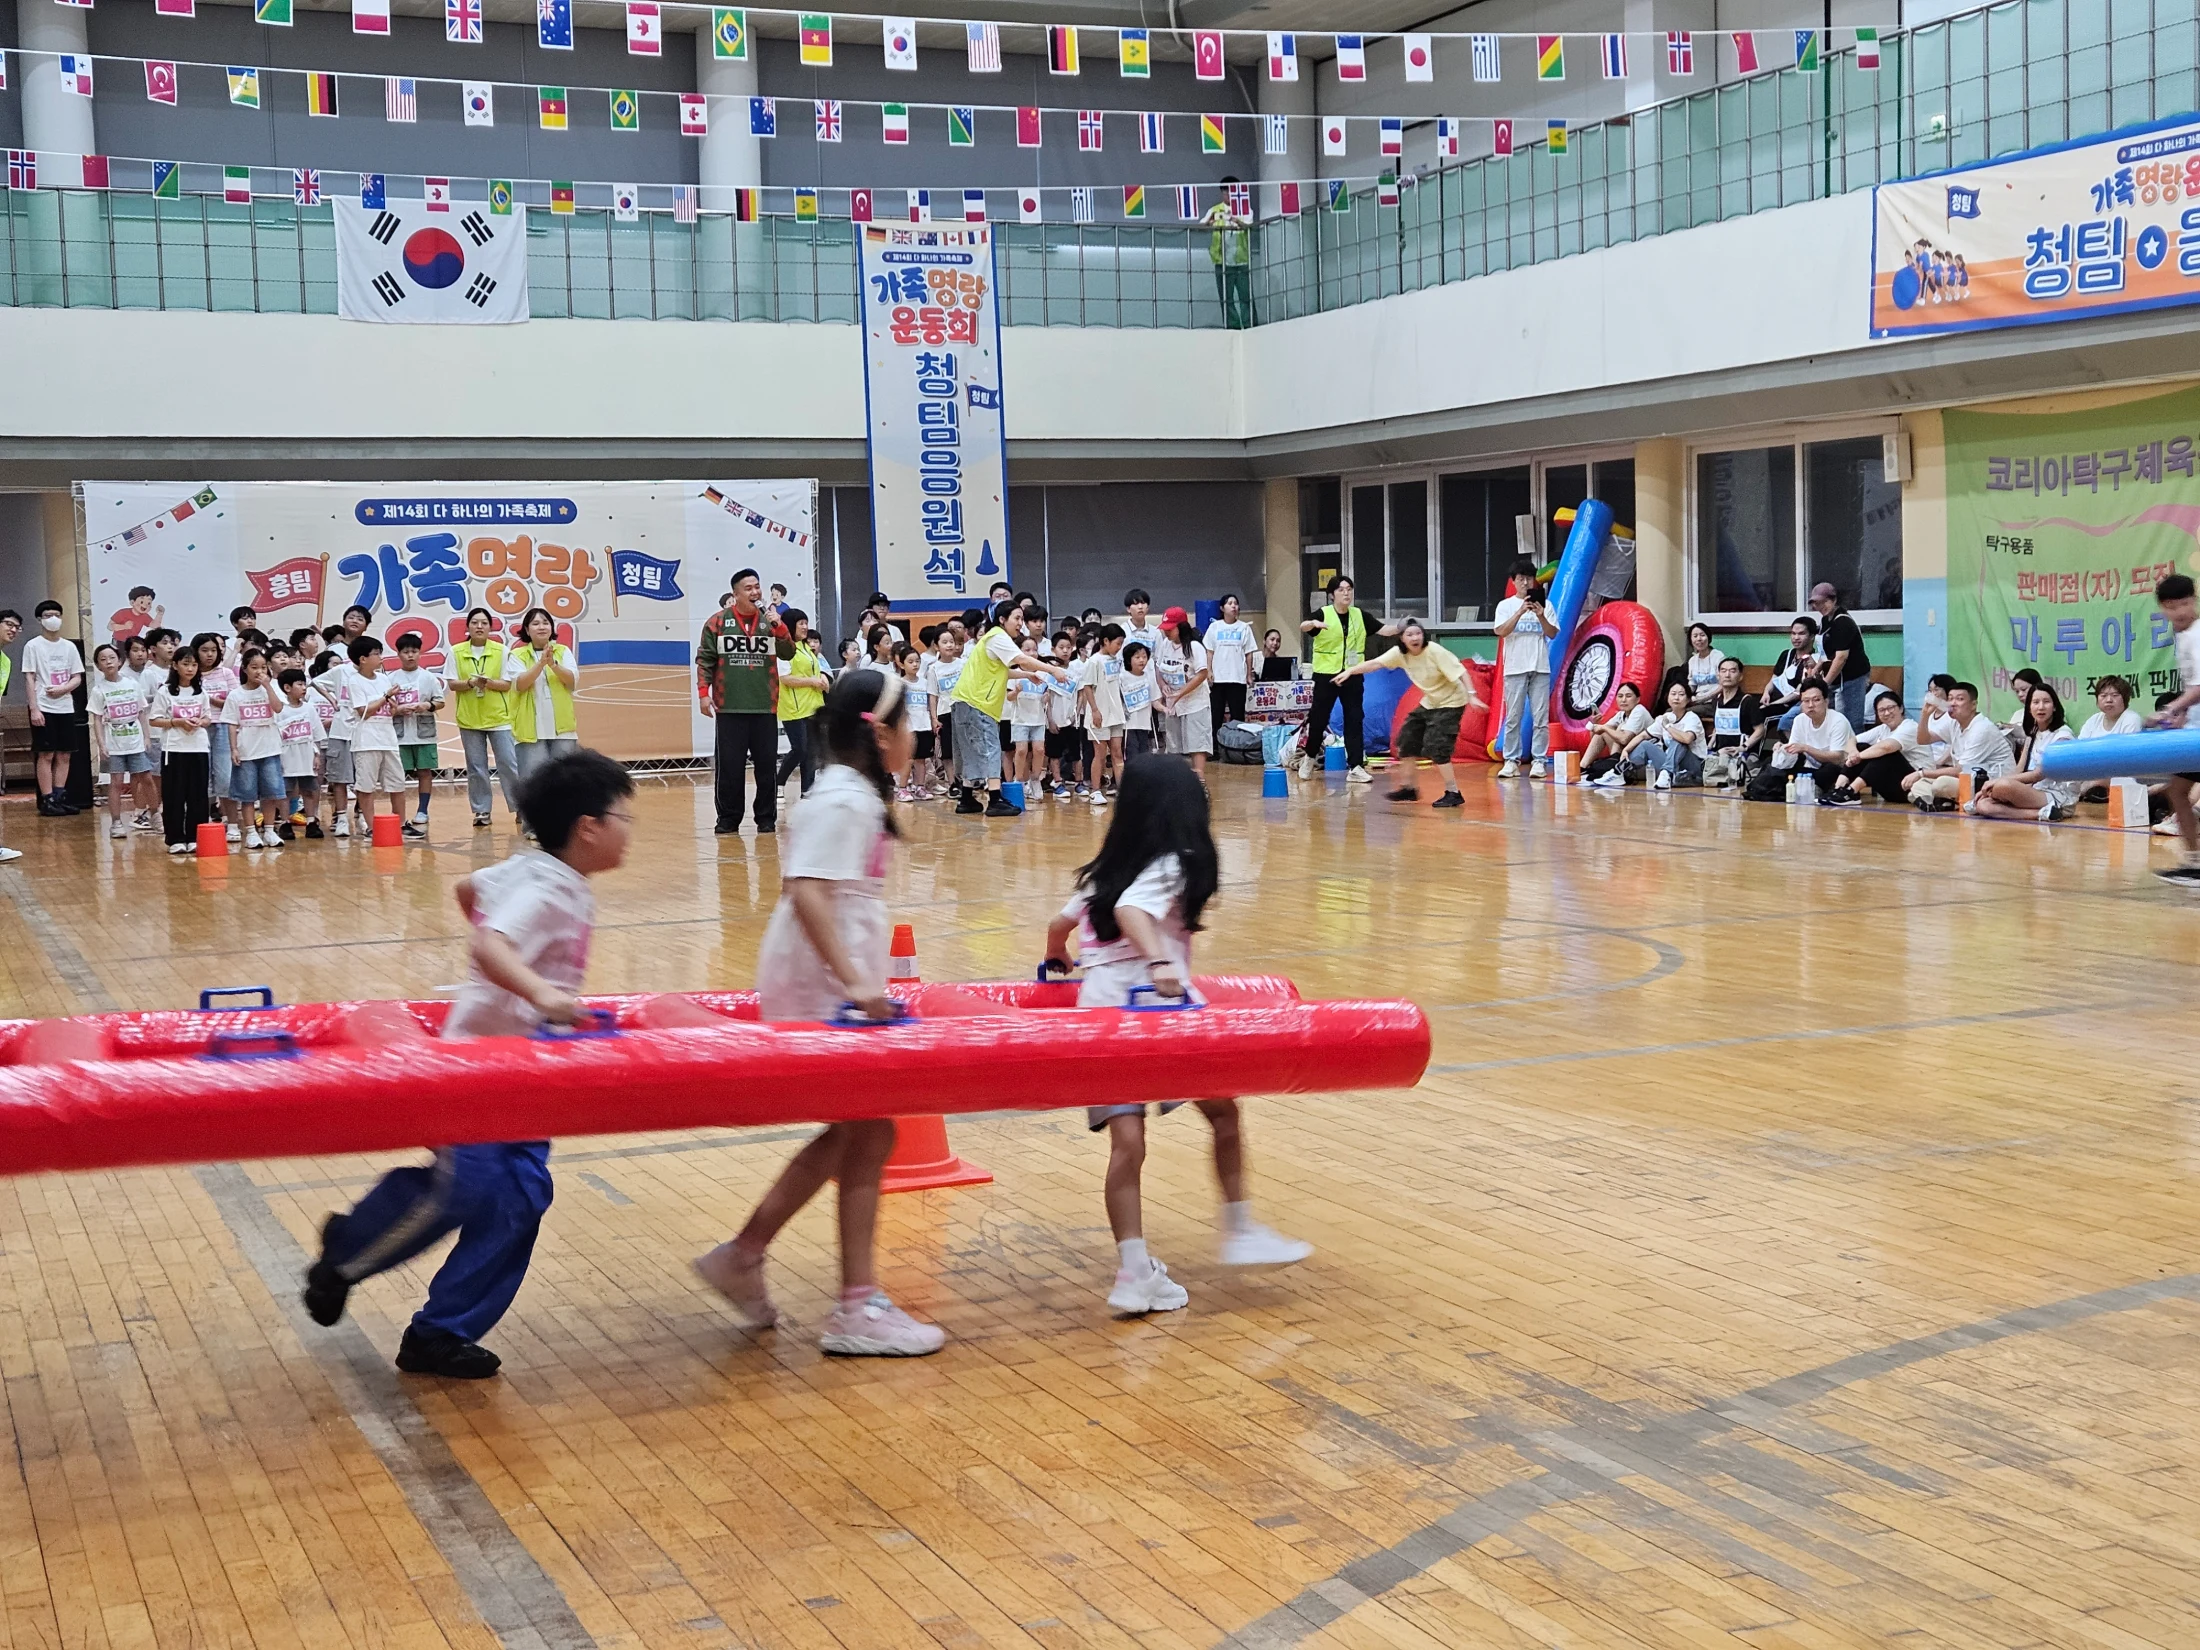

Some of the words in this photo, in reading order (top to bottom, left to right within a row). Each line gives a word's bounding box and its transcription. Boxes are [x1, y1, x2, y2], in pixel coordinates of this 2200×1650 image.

[2154, 142, 2163, 153] 다
[2164, 136, 2186, 151] 하나의
[1952, 193, 1972, 212] 청팀
[2025, 215, 2124, 296] 청팀
[889, 306, 977, 345] 운동회
[971, 389, 990, 405] 청팀
[1986, 435, 2200, 497] 코리아탁구체육
[382, 503, 429, 519] 제14회
[433, 504, 448, 518] 다
[451, 504, 493, 518] 하나의
[497, 503, 552, 518] 가족축제
[1986, 535, 2035, 555] 탁구용품
[268, 569, 312, 599] 홍팀
[622, 562, 662, 590] 청팀
[2017, 567, 2121, 604] 판매점(자)
[723, 636, 769, 653] DEUS
[1130, 688, 1149, 703] 089
[115, 703, 138, 716] 088
[317, 706, 335, 717] 32
